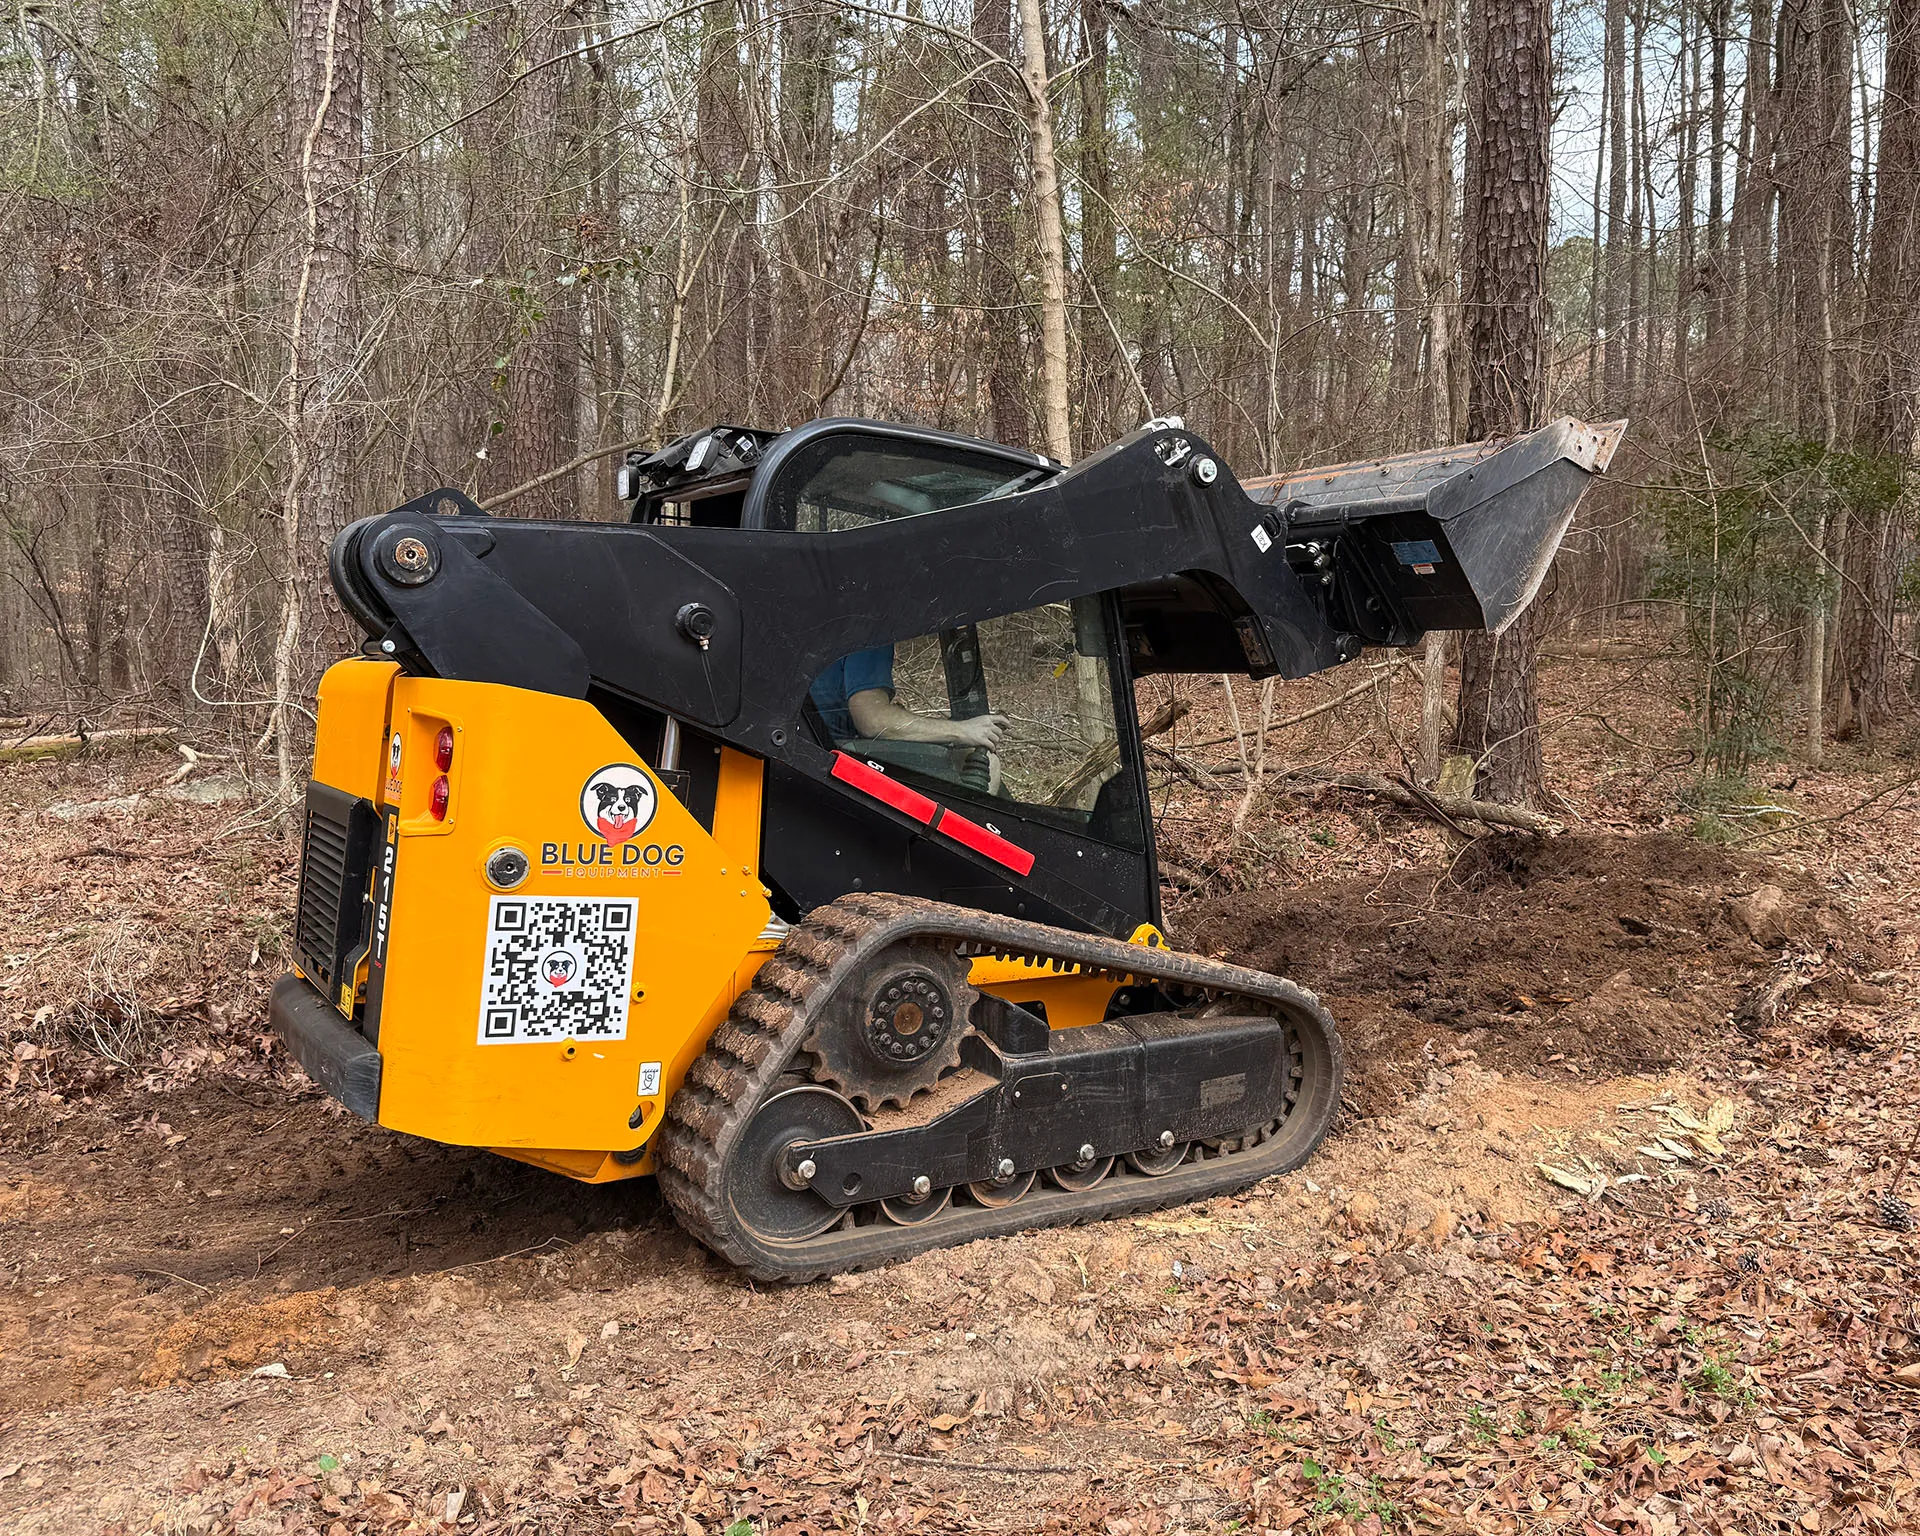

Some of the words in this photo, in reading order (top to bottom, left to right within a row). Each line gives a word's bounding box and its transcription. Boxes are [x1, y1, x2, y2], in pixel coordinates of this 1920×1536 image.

[541, 842, 613, 865] BLUE
[622, 844, 685, 866] DOG
[565, 867, 660, 878] EQUIPMENT
[377, 845, 394, 960] 215T
